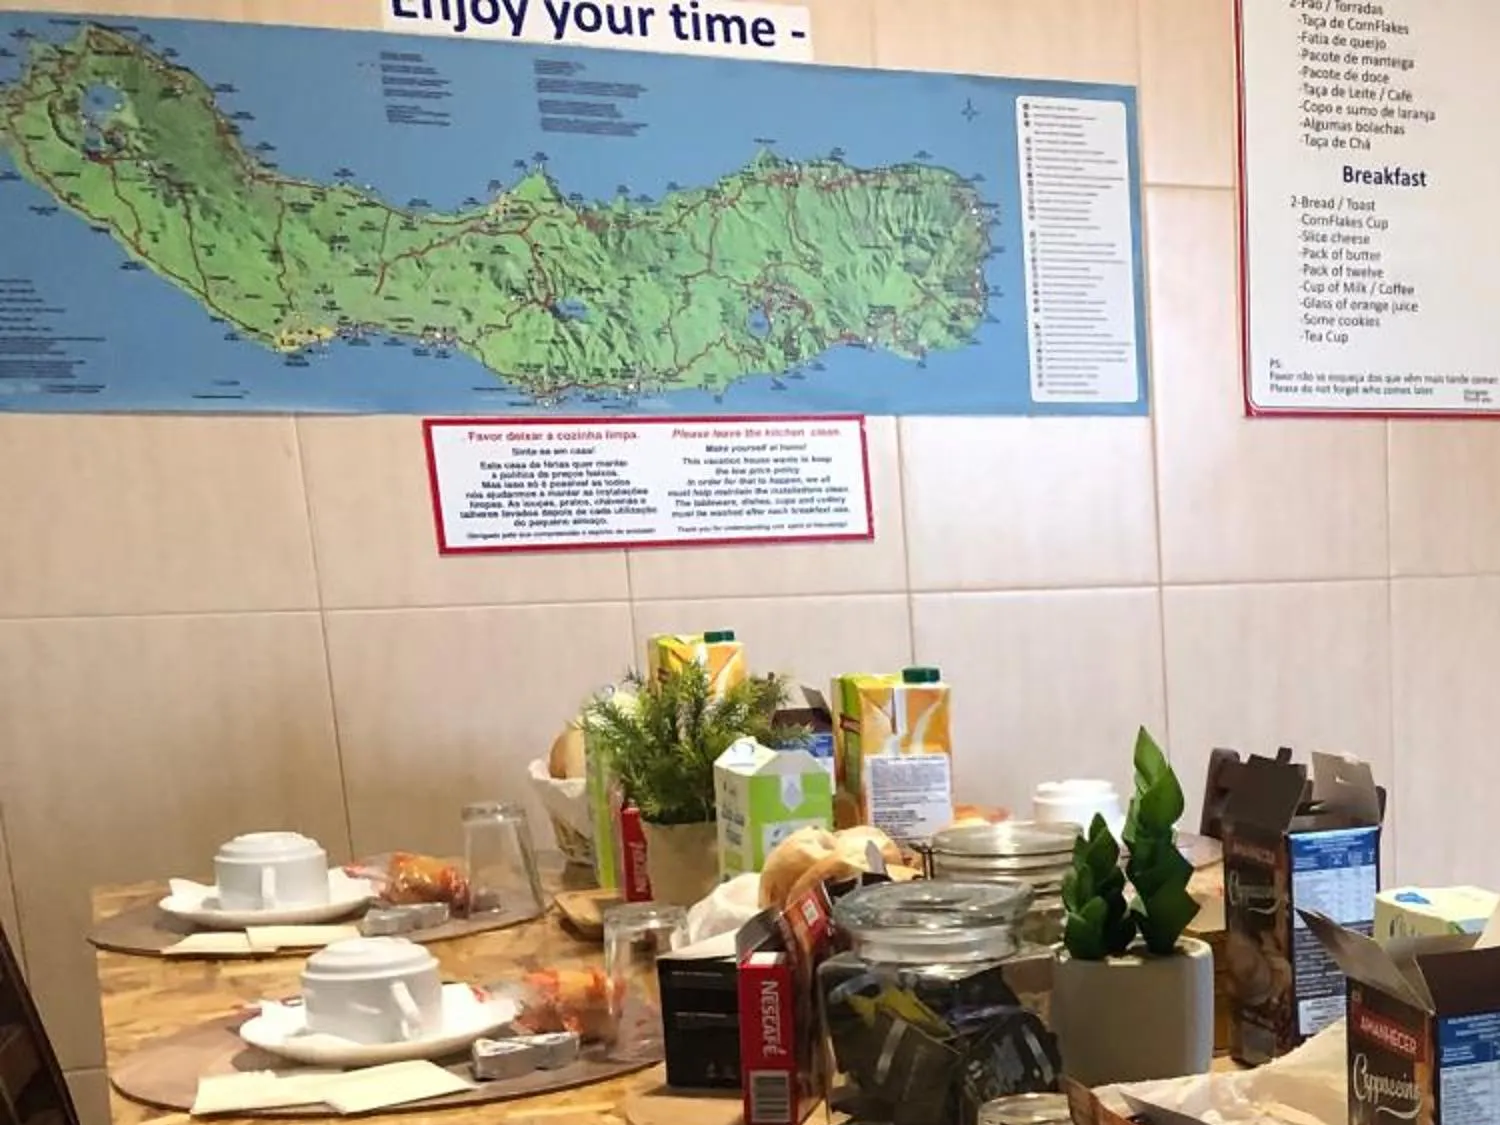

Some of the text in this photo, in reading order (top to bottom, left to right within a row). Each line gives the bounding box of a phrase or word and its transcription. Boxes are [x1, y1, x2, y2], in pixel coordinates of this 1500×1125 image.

[544, 1, 655, 40] your
[669, 1, 775, 47] time
[1330, 17, 1345, 29] de
[1347, 18, 1410, 35] CornFlakes
[1332, 34, 1347, 47] de
[1350, 36, 1387, 51] queijo
[1343, 53, 1359, 64] de
[1361, 55, 1415, 71] manteiga
[1344, 70, 1359, 81] de
[1361, 71, 1390, 84] doce
[1331, 86, 1346, 98] de
[1349, 87, 1377, 100] Leite
[1387, 88, 1413, 101] Café
[1336, 105, 1343, 114] e
[1346, 106, 1378, 117] sumo
[1380, 106, 1395, 118] de
[1397, 107, 1436, 122] laranja
[1355, 120, 1406, 135] bolachas
[1331, 136, 1346, 148] de
[1349, 136, 1371, 150] Chá
[1342, 164, 1428, 188] Breakfast
[1346, 198, 1376, 212] Toast
[1366, 216, 1389, 231] Cup
[1330, 231, 1371, 245] cheese
[1331, 248, 1343, 261] of
[1346, 249, 1382, 262] butter
[1331, 264, 1343, 278] of
[1346, 265, 1384, 279] twelve
[1328, 282, 1340, 294] of
[1343, 282, 1368, 295] Milk
[1379, 283, 1415, 296] Coffee
[1336, 298, 1347, 311] of
[1350, 301, 1389, 314] orange
[1391, 300, 1419, 315] juice
[1338, 314, 1381, 328] cookies
[1326, 331, 1349, 344] Cup
[467, 430, 503, 442] Favor
[506, 430, 544, 442] deixar
[557, 429, 603, 442] cozinha
[671, 427, 710, 439] Please
[712, 427, 742, 438] leave
[744, 427, 762, 438] the
[764, 427, 805, 438] kitchen
[760, 980, 788, 1058] NESCAFÉ
[1359, 1014, 1418, 1055] AMANHECER
